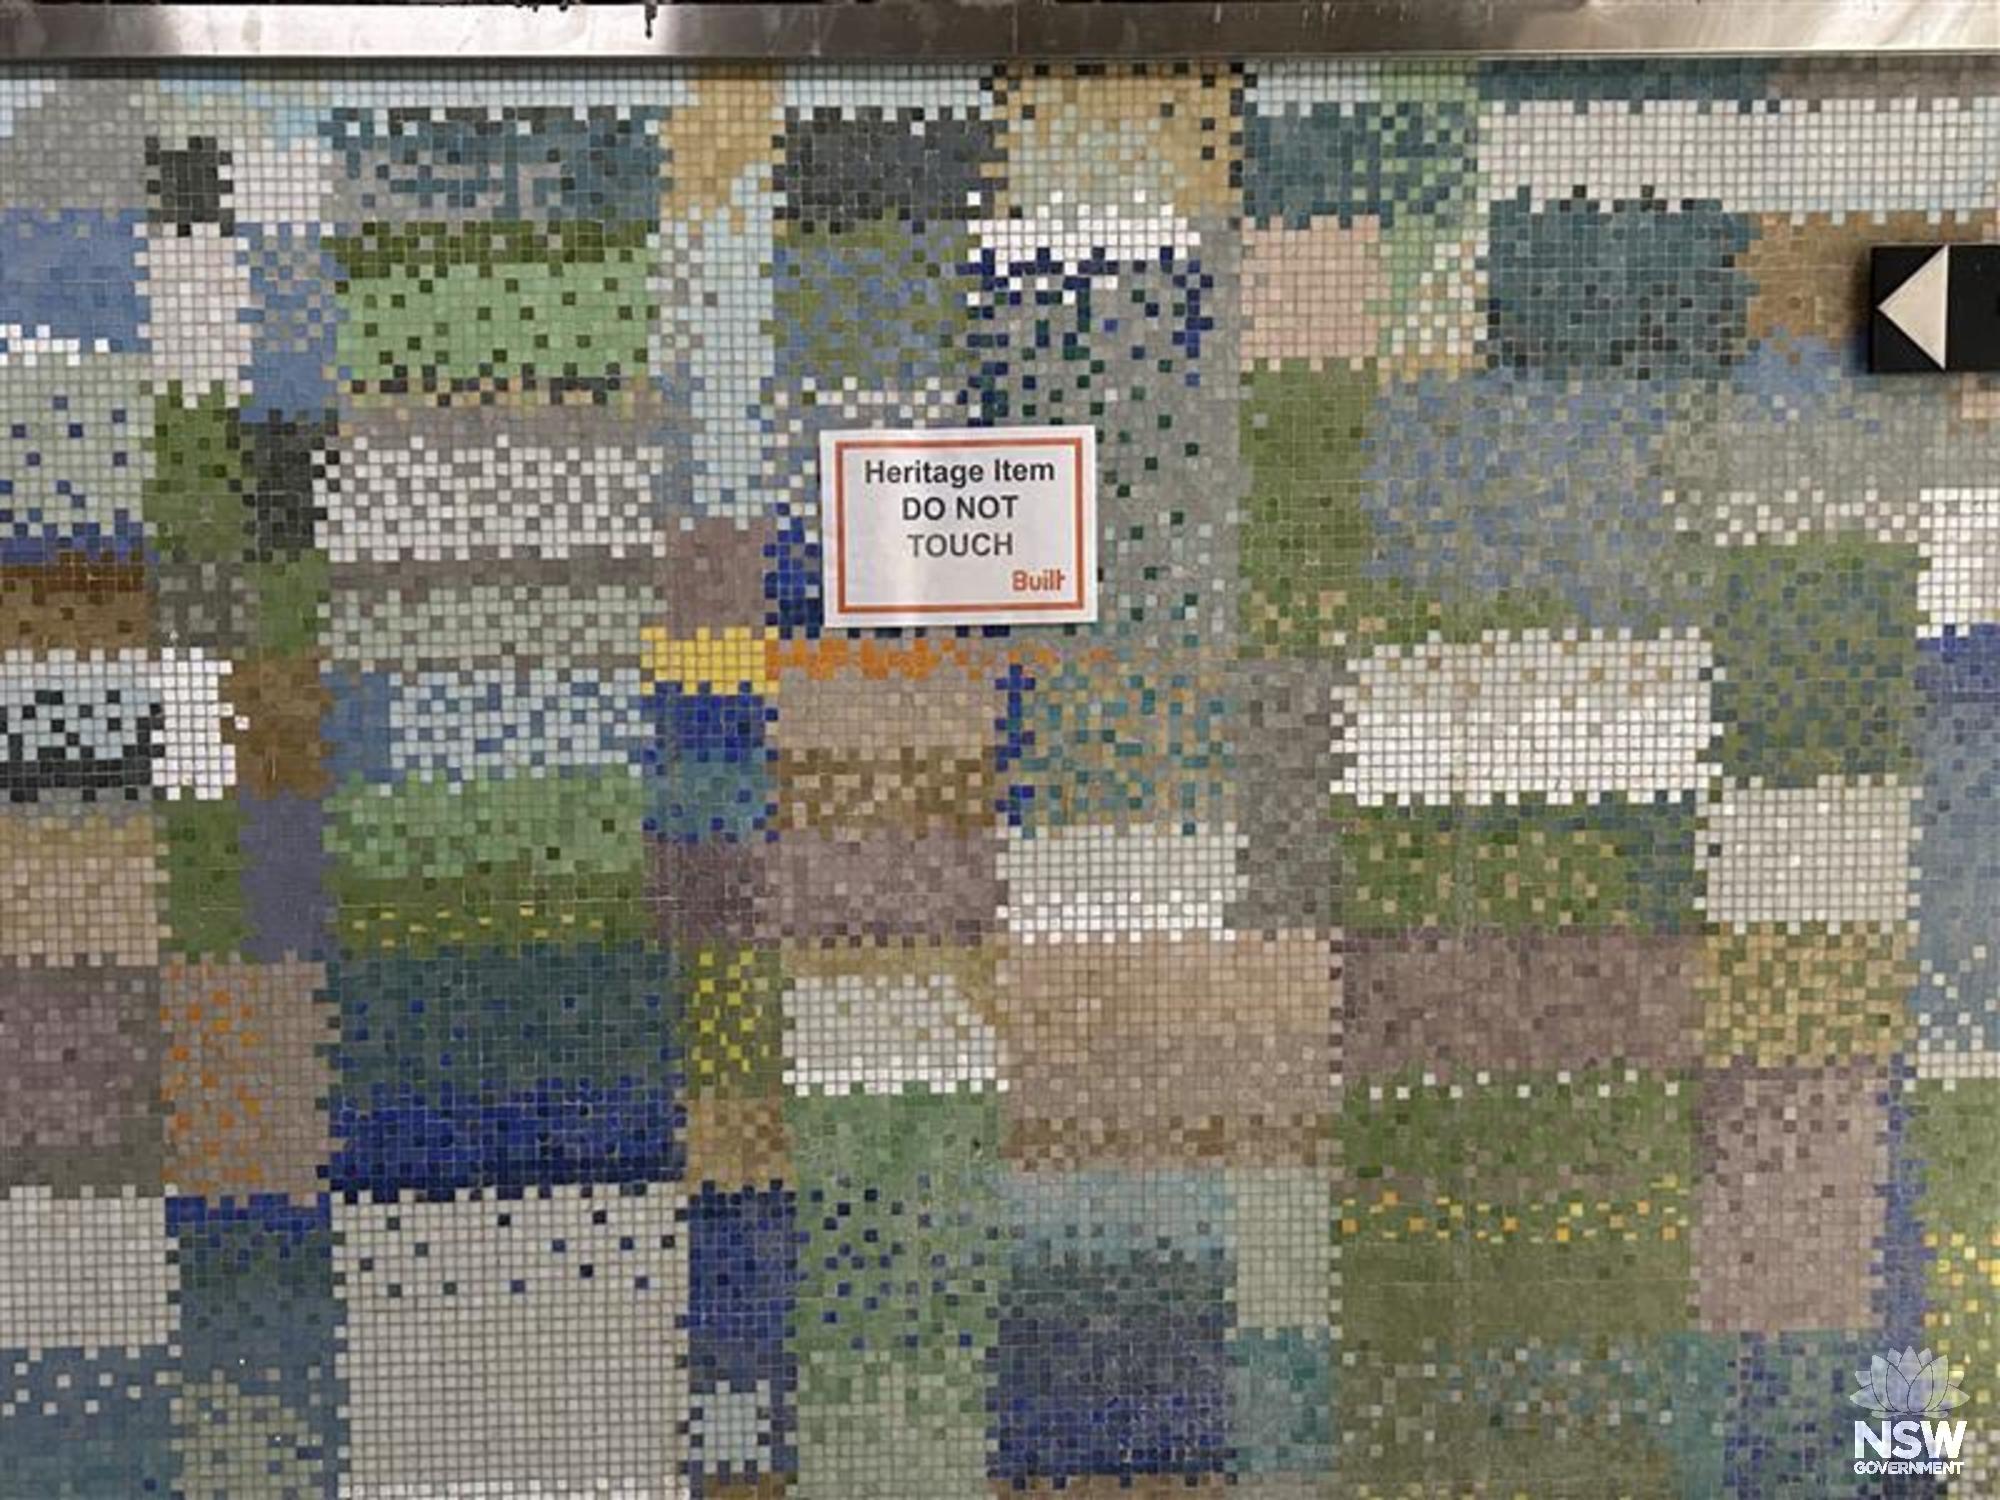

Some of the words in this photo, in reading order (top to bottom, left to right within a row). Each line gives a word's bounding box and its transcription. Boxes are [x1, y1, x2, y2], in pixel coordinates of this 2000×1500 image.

[865, 460, 984, 488] Heritage
[994, 459, 1055, 481] Item
[902, 497, 946, 520] DO
[956, 495, 1018, 520] NOT
[907, 533, 1013, 557] TOUCH
[1012, 570, 1065, 591] Built
